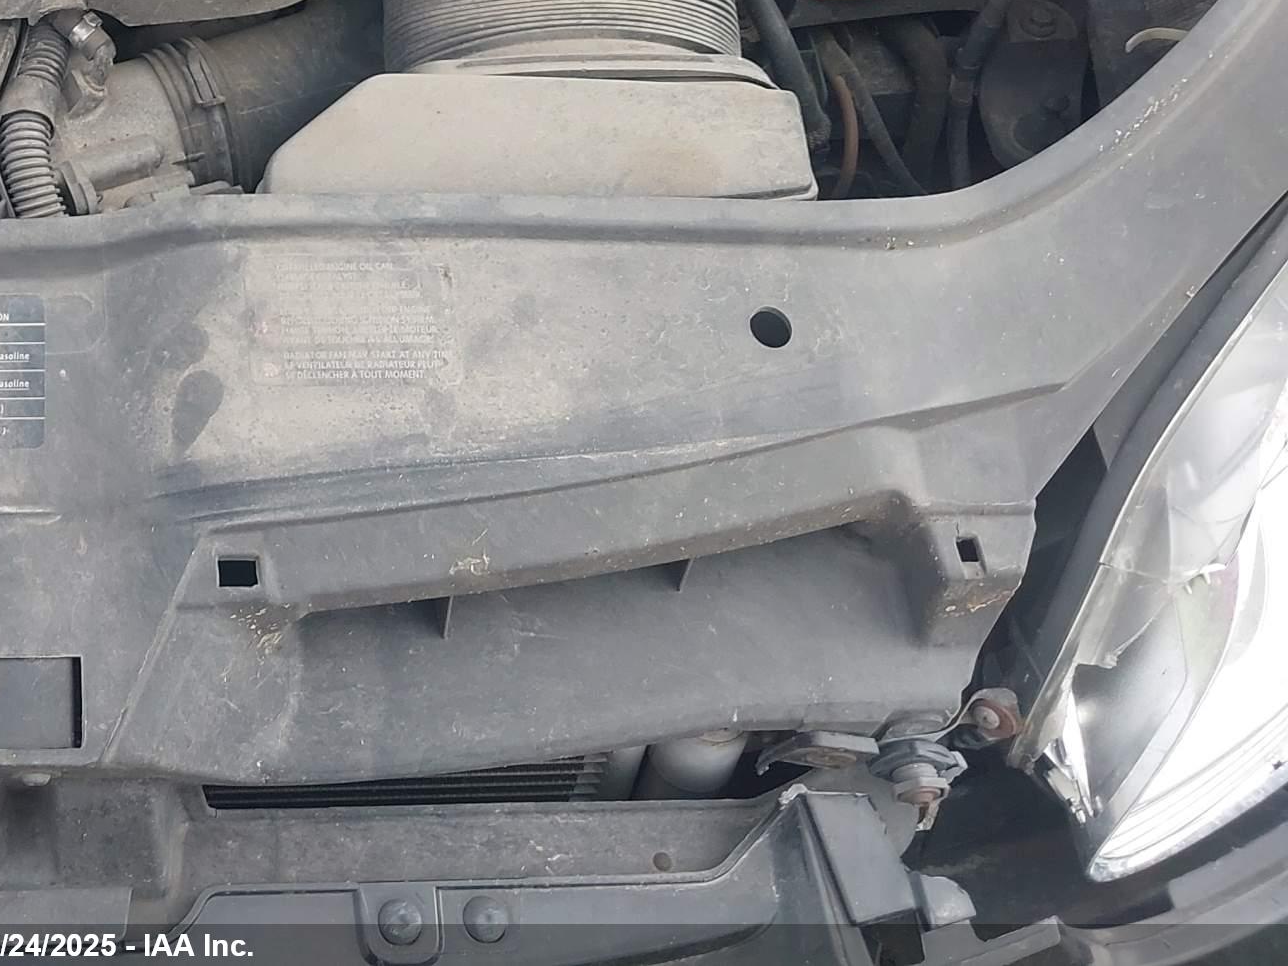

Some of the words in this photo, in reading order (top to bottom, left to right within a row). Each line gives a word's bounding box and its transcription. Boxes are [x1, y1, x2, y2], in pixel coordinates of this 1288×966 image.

[399, 349, 410, 359] AT
[367, 360, 416, 369] RADIATEUR
[359, 369, 383, 379] TOUT
